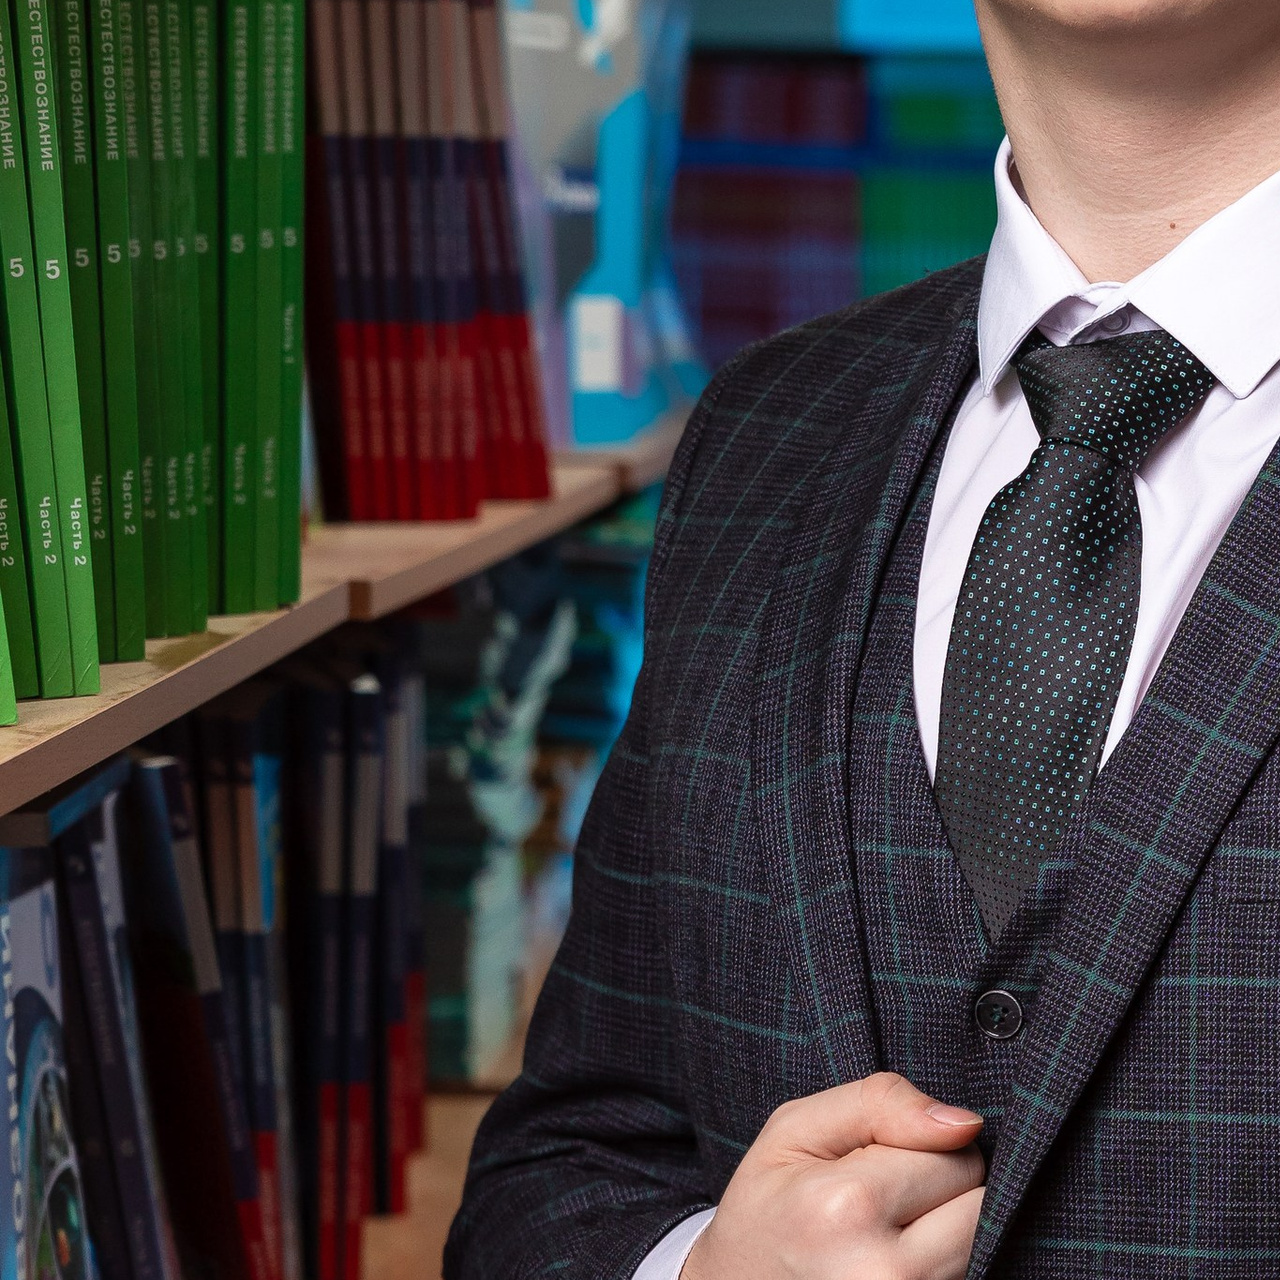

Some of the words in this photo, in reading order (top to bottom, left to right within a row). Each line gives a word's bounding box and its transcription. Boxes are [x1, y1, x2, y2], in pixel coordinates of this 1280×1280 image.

[66, 0, 87, 165] ЕСТЕСТВОЗНАНИЕ
[0, 33, 15, 169] ВОЗНАНИЕ
[75, 248, 90, 267] 5
[107, 244, 121, 263] 5
[9, 258, 24, 278] 5
[45, 259, 60, 279] 5
[91, 475, 103, 524] Часть
[123, 469, 134, 519] Часть
[0, 499, 9, 551] Часть
[39, 496, 51, 549] Часть
[70, 498, 82, 550] Часть
[124, 525, 136, 535] 2
[94, 529, 105, 539] 2
[2, 557, 14, 566] 2
[44, 554, 57, 565] 2
[74, 555, 87, 566] 2
